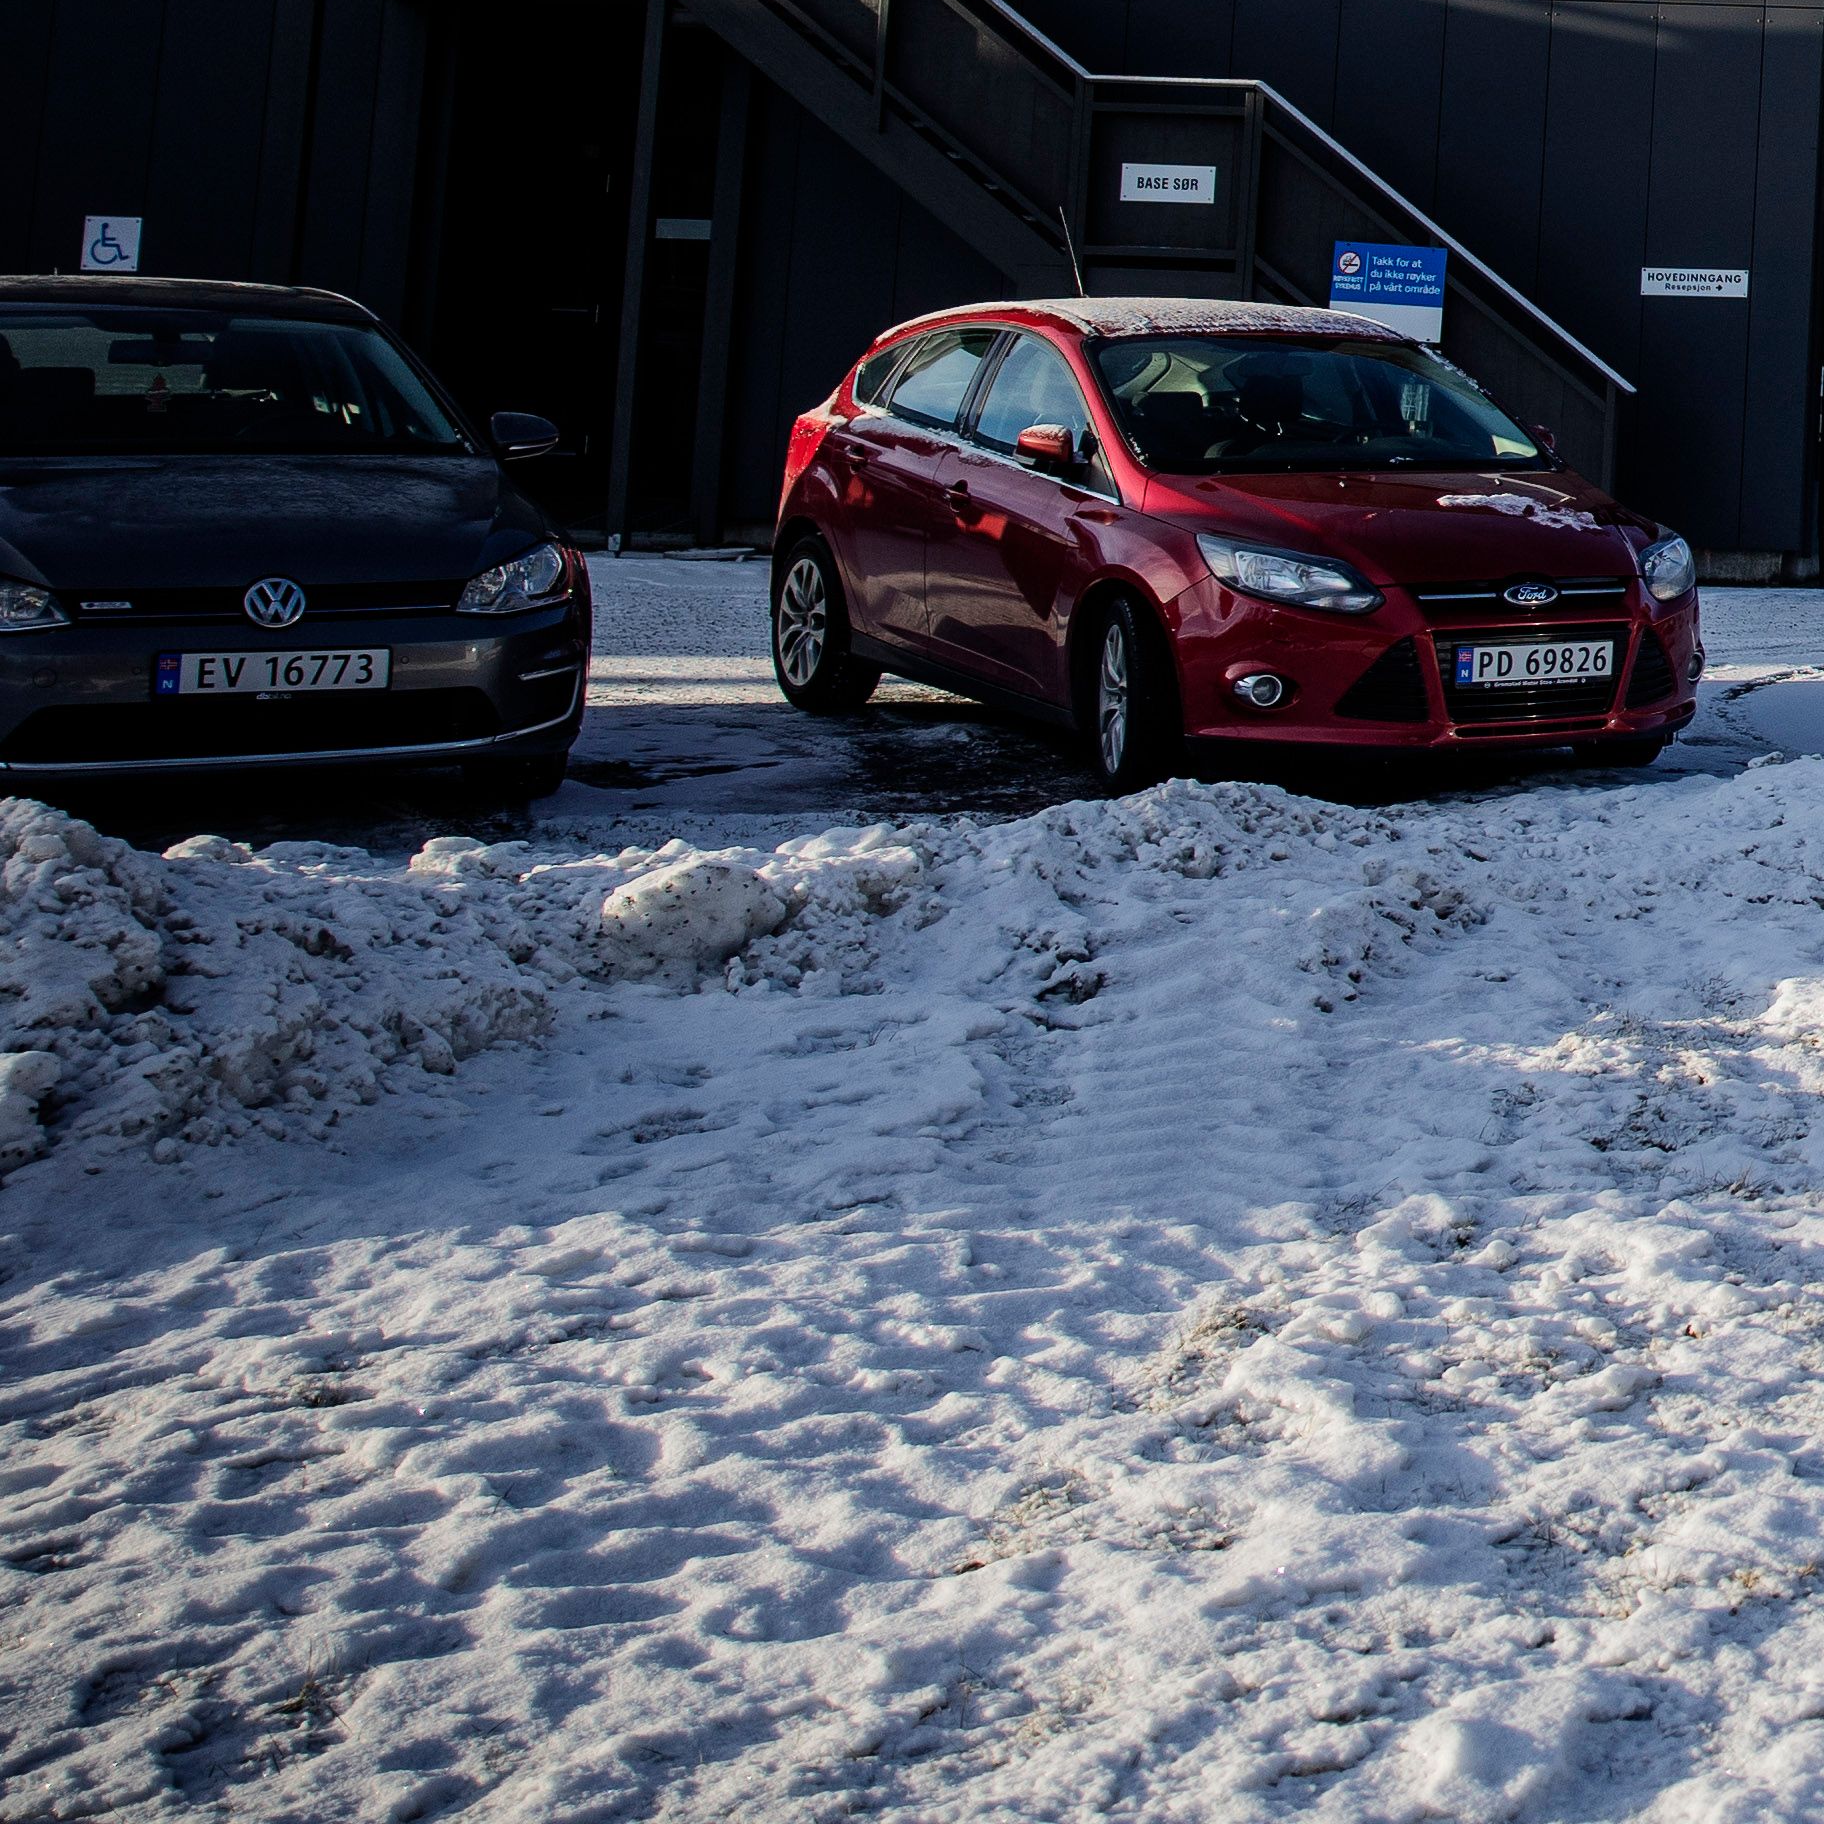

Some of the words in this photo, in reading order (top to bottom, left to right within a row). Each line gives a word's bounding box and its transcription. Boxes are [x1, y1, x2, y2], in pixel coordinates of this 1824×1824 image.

[1137, 177, 1169, 190] BASE
[1173, 178, 1199, 190] SØR
[1372, 256, 1394, 266] Takk
[1396, 257, 1410, 267] for
[1411, 259, 1423, 268] at
[1370, 269, 1382, 278] du
[1384, 269, 1404, 279] ikke
[1406, 272, 1436, 283] røyker
[1647, 272, 1742, 283] HOVEDINNGANG
[1369, 281, 1381, 292] på
[1383, 282, 1402, 292] vårt
[1404, 283, 1440, 295] område
[1664, 283, 1712, 292] Resepsjon
[1517, 586, 1547, 600] Ford
[1478, 651, 1513, 678] PD
[1525, 646, 1607, 676] 69826
[198, 657, 247, 689] EV
[265, 654, 373, 687] 16773
[1461, 669, 1469, 678] N
[162, 680, 173, 689] N
